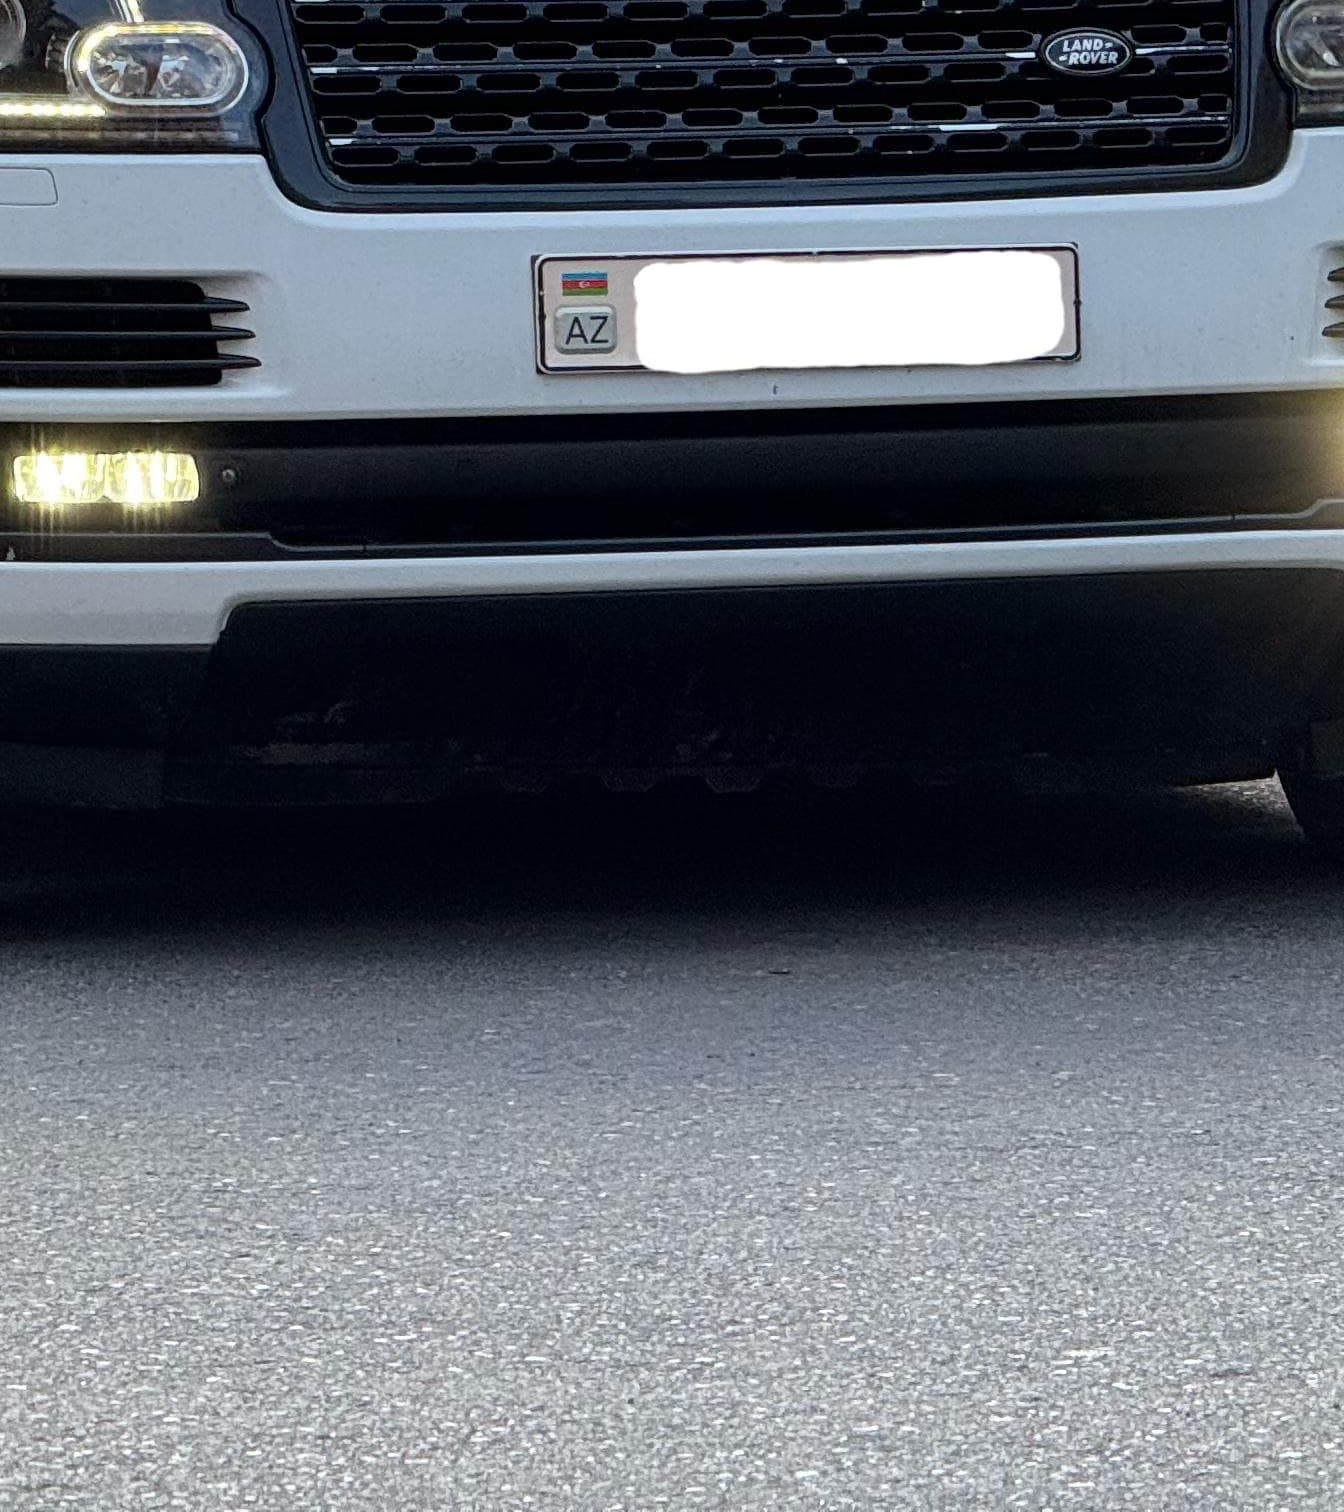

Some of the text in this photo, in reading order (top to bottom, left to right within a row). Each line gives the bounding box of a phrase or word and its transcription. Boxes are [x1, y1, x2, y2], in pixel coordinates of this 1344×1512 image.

[1062, 39, 1104, 53] LAND
[1067, 51, 1119, 66] ROVER
[564, 315, 610, 346] AZ
